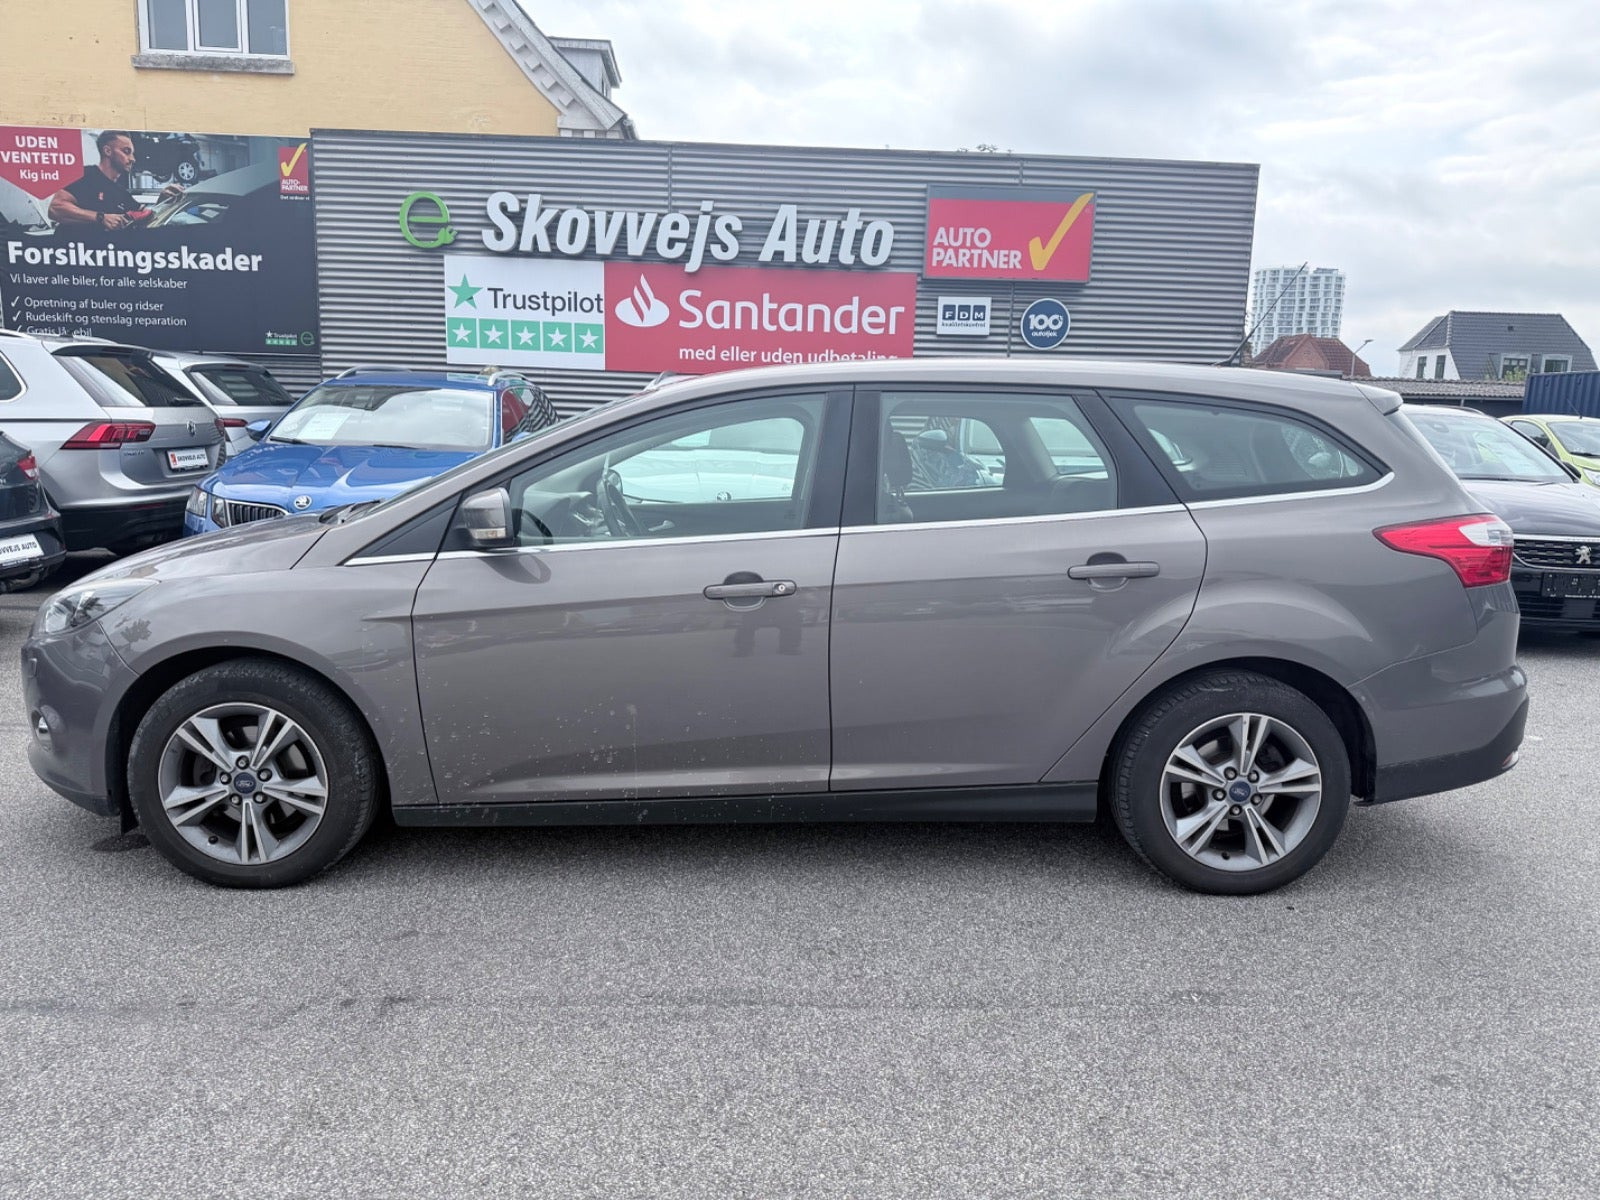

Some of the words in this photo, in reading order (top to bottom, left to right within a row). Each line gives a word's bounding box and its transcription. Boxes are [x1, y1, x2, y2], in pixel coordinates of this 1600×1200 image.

[15, 135, 58, 149] UDEN
[0, 150, 76, 166] VENTETID
[20, 169, 39, 182] Kig
[41, 170, 59, 181] ind
[482, 191, 743, 273] Skovvejs
[759, 203, 895, 268] Auto
[933, 227, 992, 248] AUTO
[8, 241, 263, 274] Forsikringsskader
[932, 248, 1022, 270] PARTNER
[10, 273, 21, 283] Vi
[23, 274, 48, 285] laver
[51, 276, 70, 286] alle
[72, 276, 98, 287] biler,
[100, 277, 115, 287] for
[117, 277, 136, 288] alle
[138, 278, 188, 289] selskaber
[24, 297, 77, 310] Opretning
[79, 298, 89, 309] af
[91, 299, 117, 310] buler
[119, 303, 133, 313] og
[135, 301, 164, 311] ridser
[487, 286, 604, 317] Trustpilot
[25, 312, 73, 323] Rudeskift
[75, 315, 89, 326] og
[91, 315, 132, 326] stenslag
[134, 317, 187, 327] reparation
[678, 289, 905, 336] Santander
[944, 310, 985, 319] FDM
[26, 326, 56, 334] Gratis
[58, 327, 92, 337] låebil
[679, 345, 716, 361] med
[719, 347, 756, 362] eller
[761, 348, 803, 364] uden
[0, 545, 20, 555] VVEJS
[22, 541, 37, 550] AUTO
